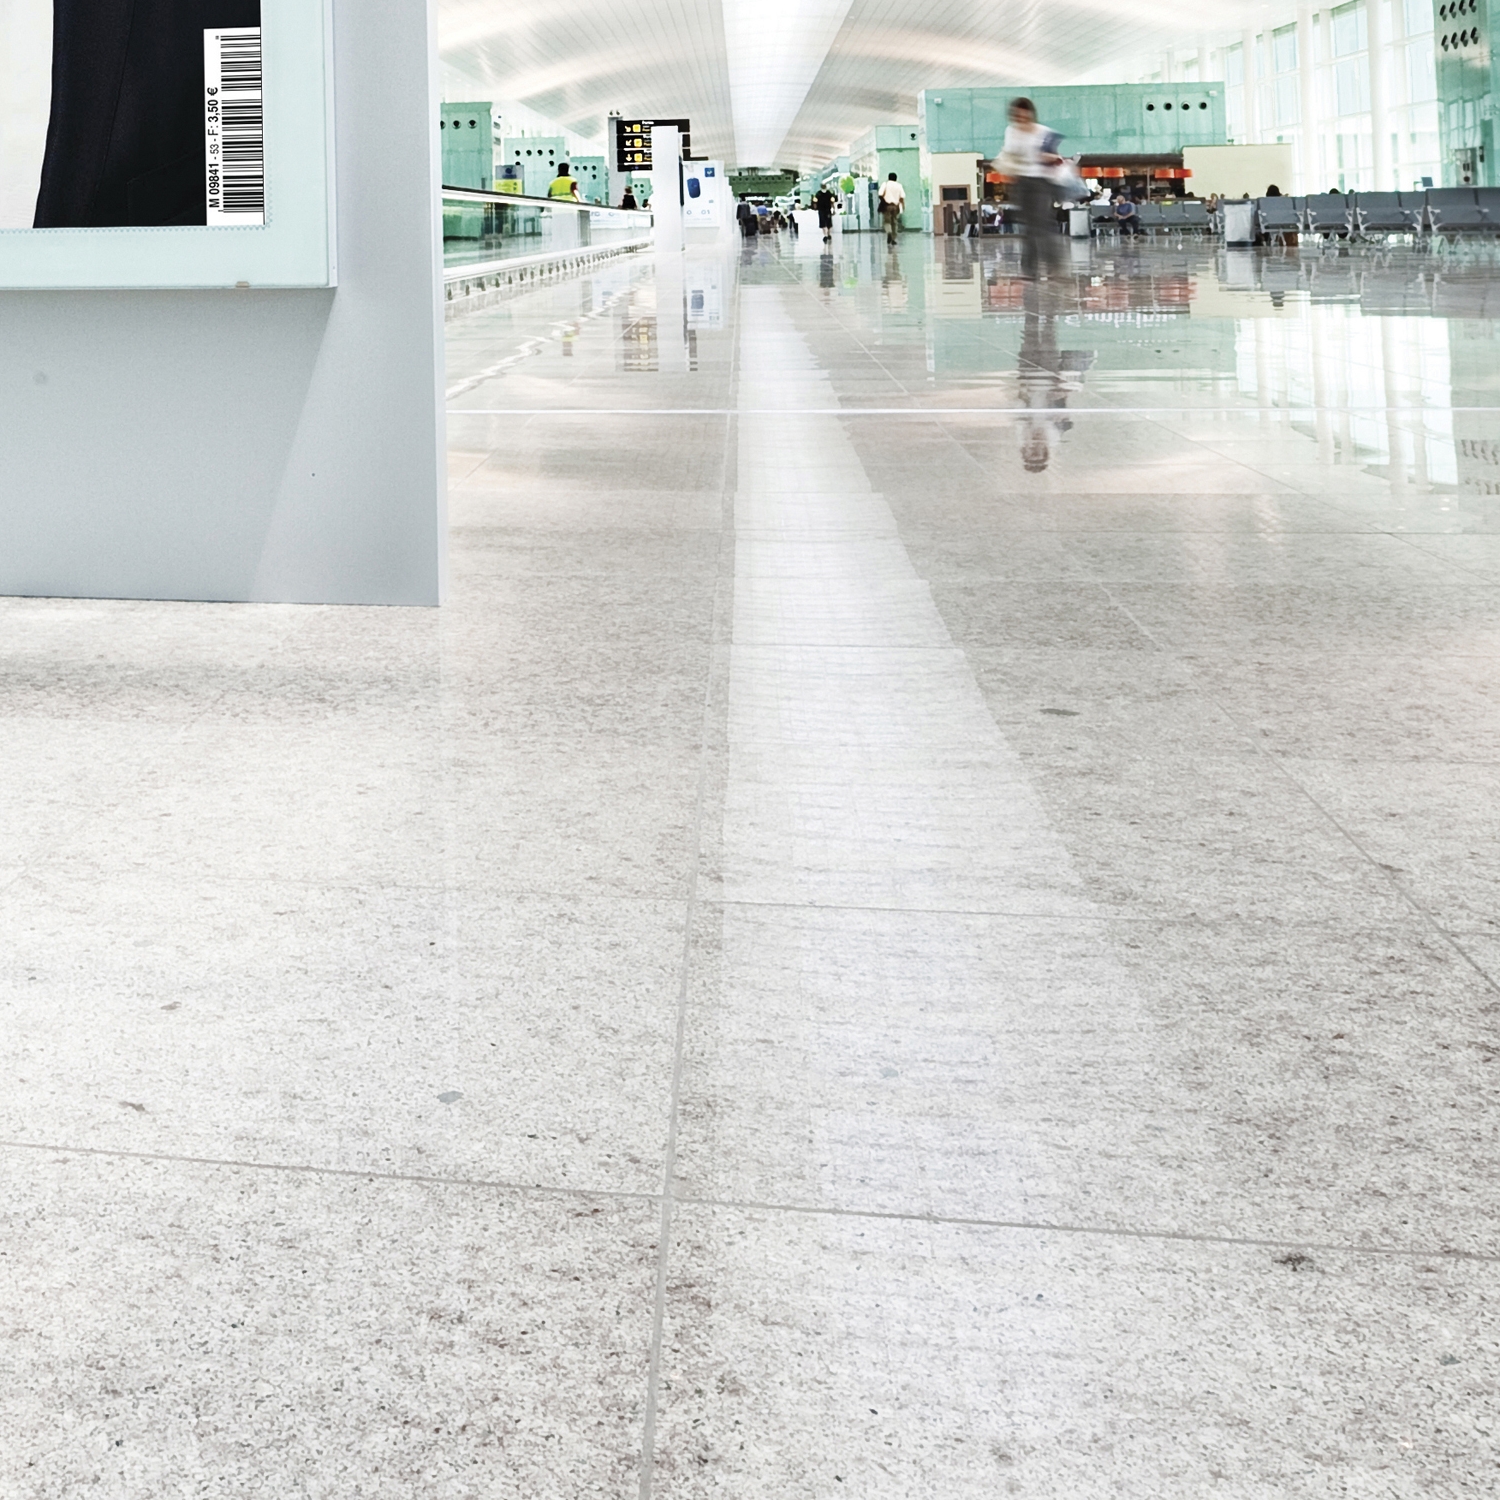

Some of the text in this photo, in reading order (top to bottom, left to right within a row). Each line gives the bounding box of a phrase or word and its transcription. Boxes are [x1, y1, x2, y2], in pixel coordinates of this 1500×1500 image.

[207, 99, 220, 122] 3,50
[210, 144, 219, 154] 53
[208, 163, 220, 195] 09841
[209, 199, 220, 208] M
